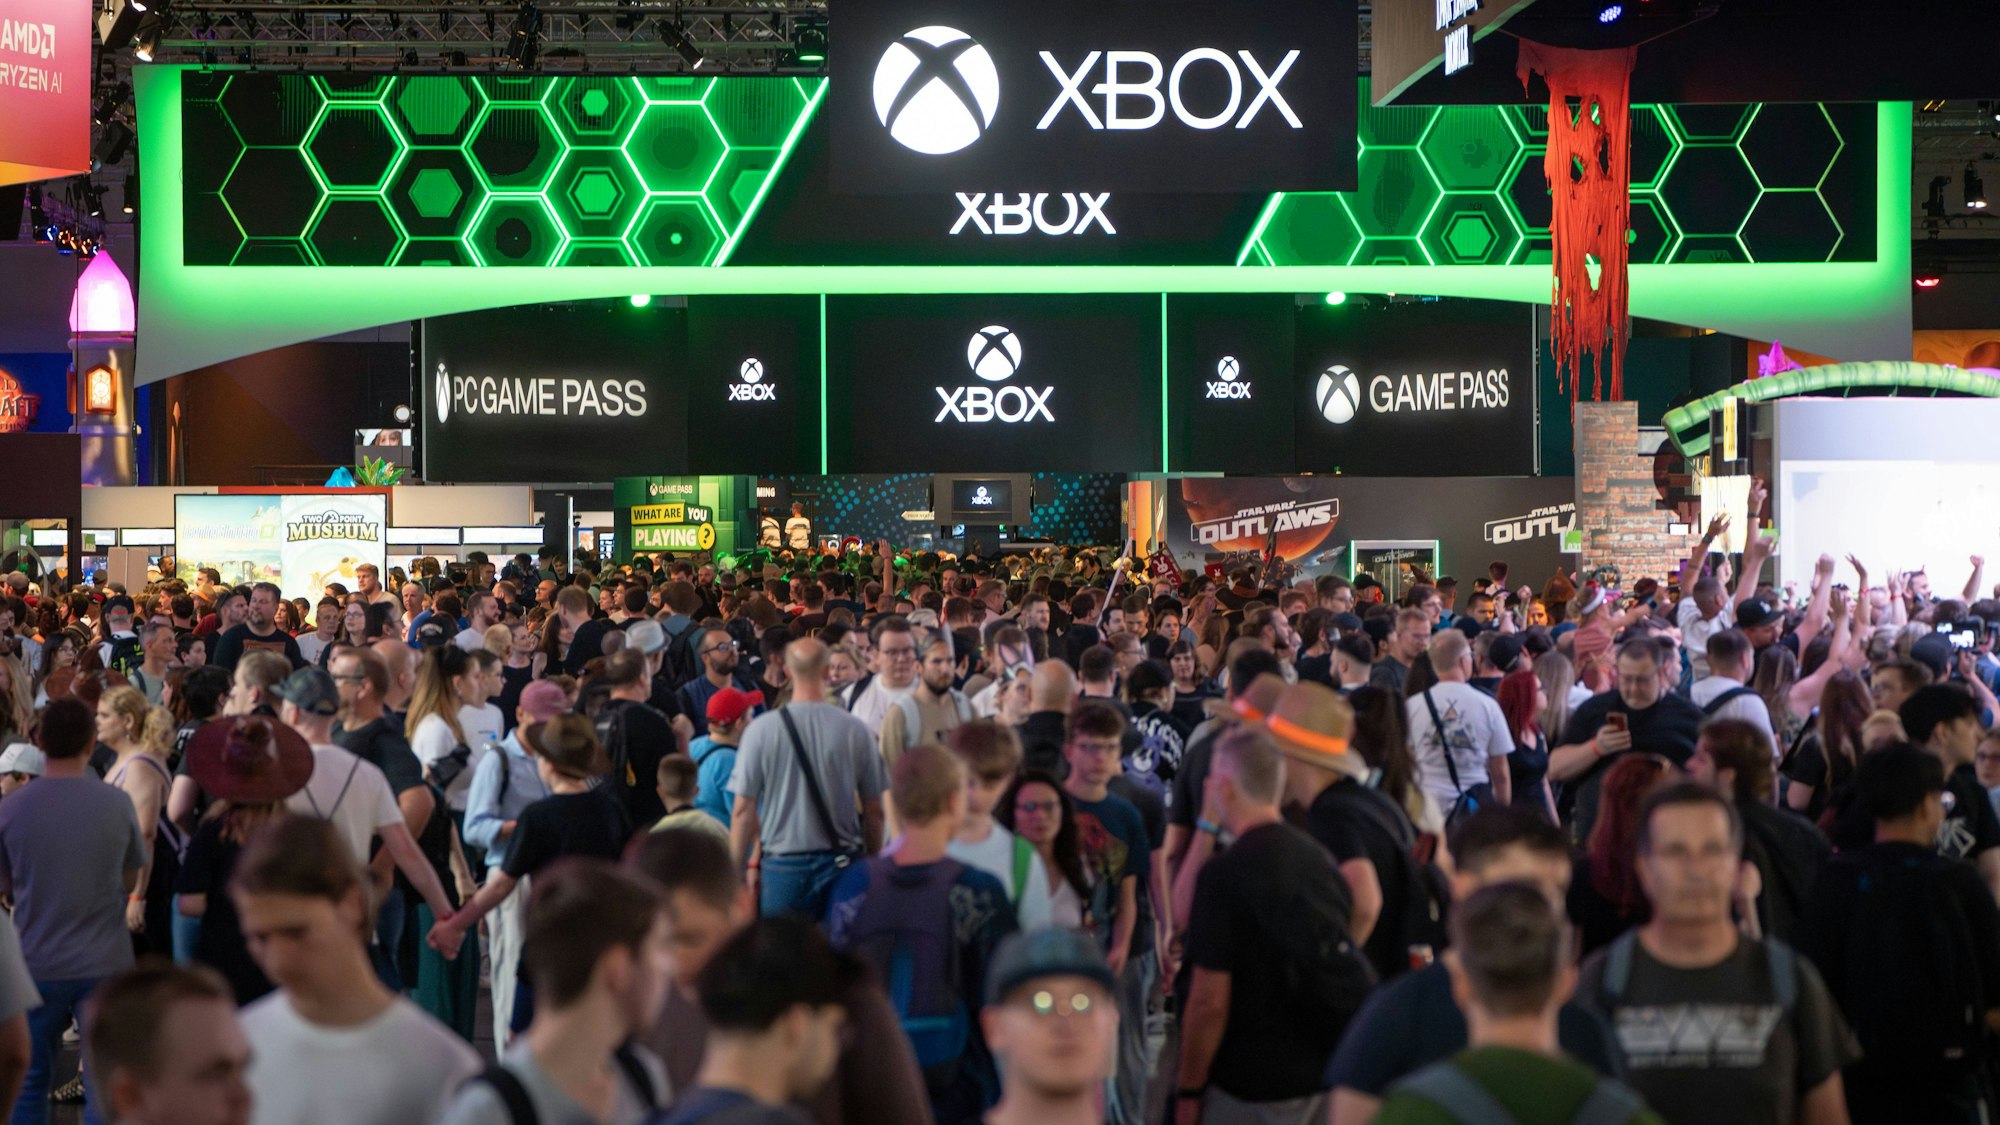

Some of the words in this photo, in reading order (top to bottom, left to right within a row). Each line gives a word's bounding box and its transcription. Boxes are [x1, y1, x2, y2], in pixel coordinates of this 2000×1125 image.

[0, 18, 41, 55] AMD
[0, 62, 48, 92] RYZEN
[50, 71, 62, 94] AI
[1036, 47, 1304, 130] XBOX
[949, 193, 1116, 236] XBOX
[453, 376, 478, 414] PC
[480, 376, 556, 415] GAME
[562, 378, 647, 417] PASS
[728, 384, 776, 401] XBOX
[1206, 382, 1252, 400] XBOX
[1369, 373, 1456, 413] GAME
[1459, 368, 1509, 409] PASS
[935, 386, 1056, 423] XBOX
[659, 485, 678, 494] GAME
[677, 484, 693, 494] PASS
[971, 496, 992, 505] XBOX
[1234, 507, 1266, 519] STAR
[1264, 500, 1296, 513] WARS
[1528, 505, 1560, 518] STAR
[1559, 502, 1576, 513] WA
[302, 514, 323, 524] TWO
[340, 514, 364, 524] POINT
[633, 508, 662, 521] WHAT
[663, 507, 682, 519] ARE
[687, 507, 708, 522] YOU
[287, 522, 378, 542] MUSEUM
[1199, 504, 1333, 545] OUTLAWS
[635, 528, 698, 547] PLAYING
